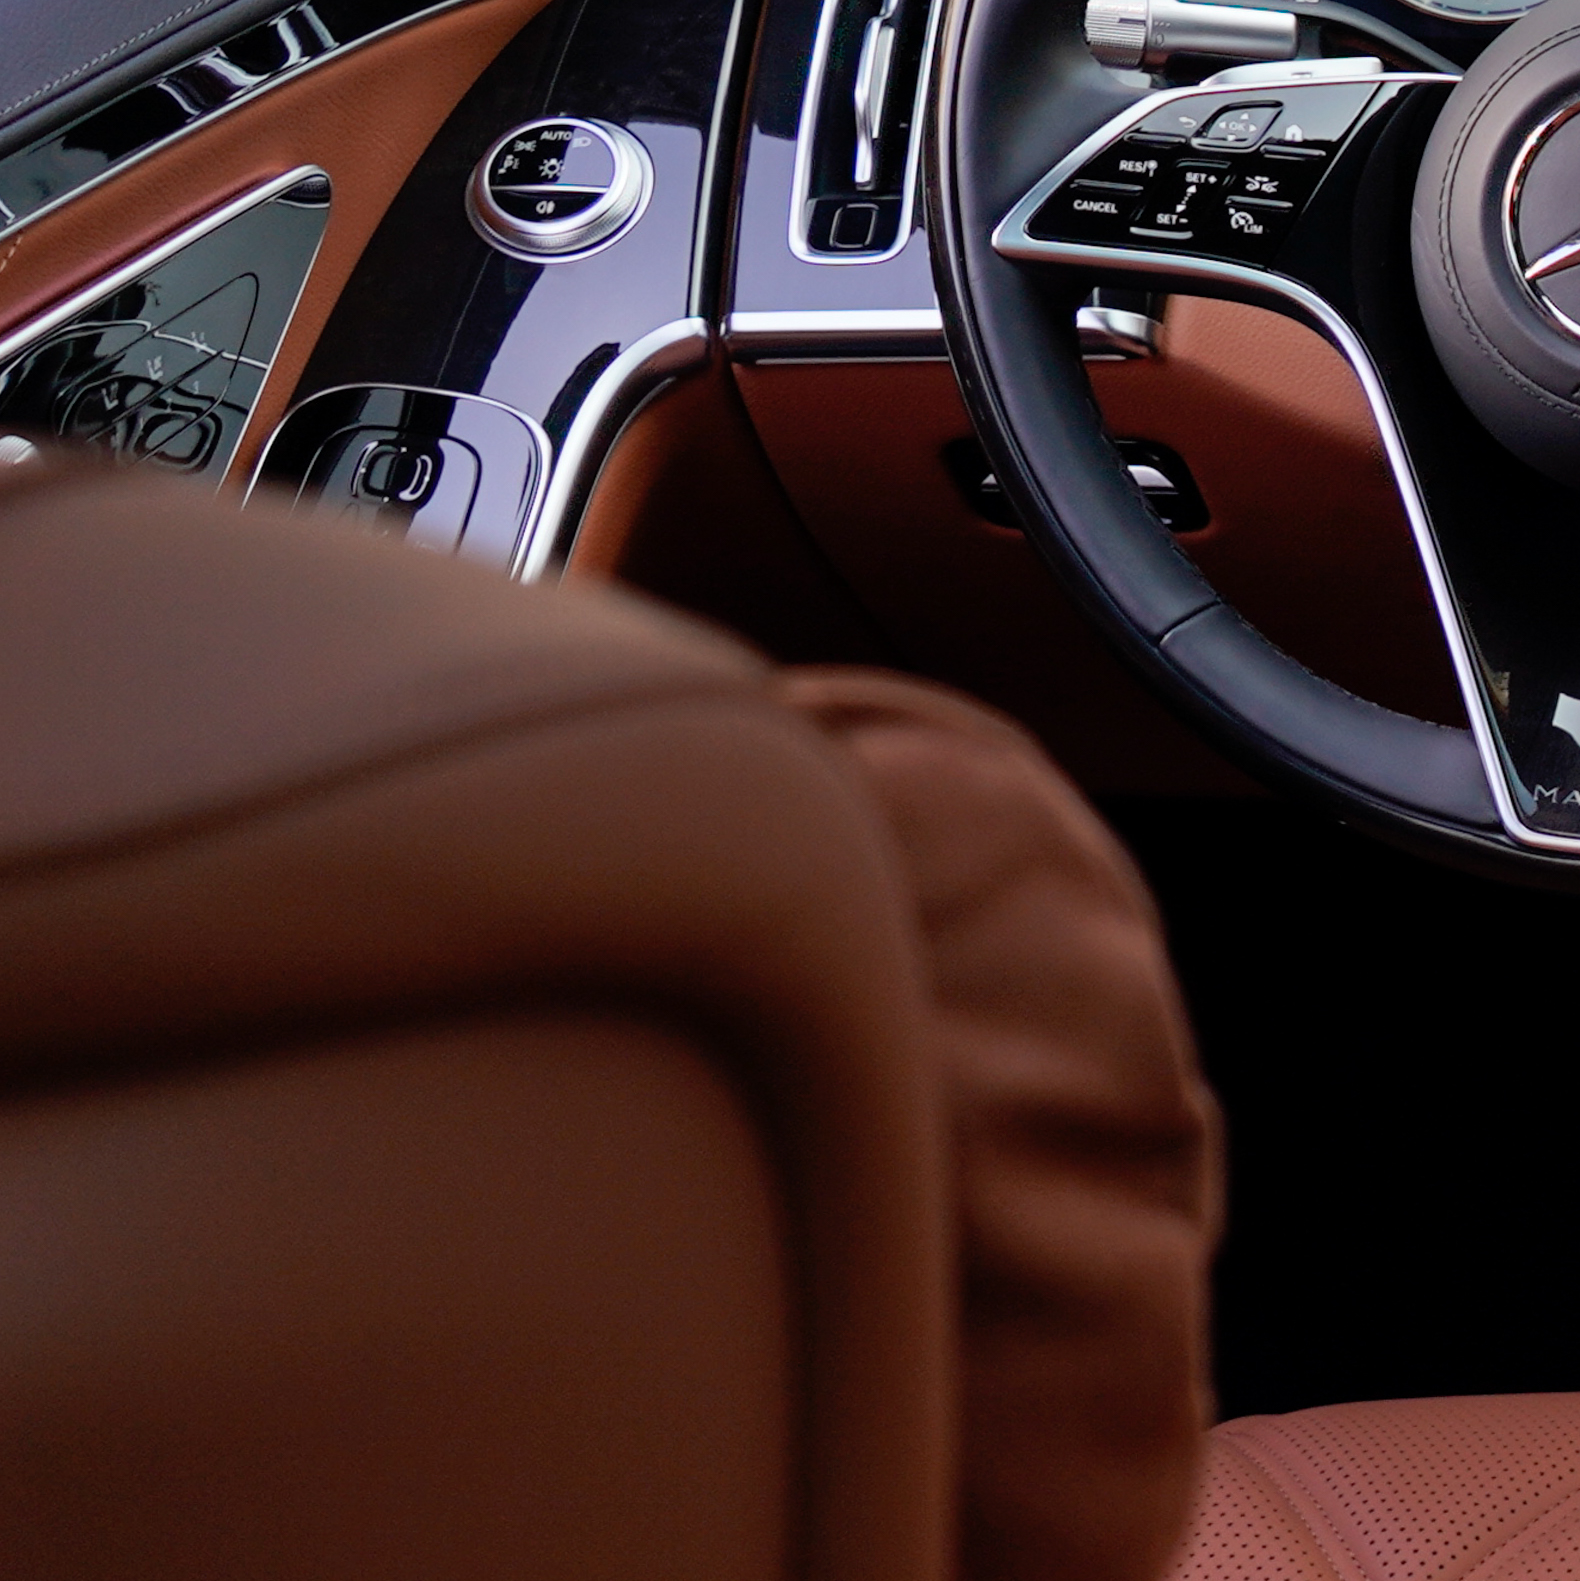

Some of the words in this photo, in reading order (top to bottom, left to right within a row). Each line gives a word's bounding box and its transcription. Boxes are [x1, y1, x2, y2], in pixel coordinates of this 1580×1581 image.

[1228, 121, 1247, 133] OK
[540, 130, 573, 141] AUTO
[1073, 198, 1118, 215] CANCEL
